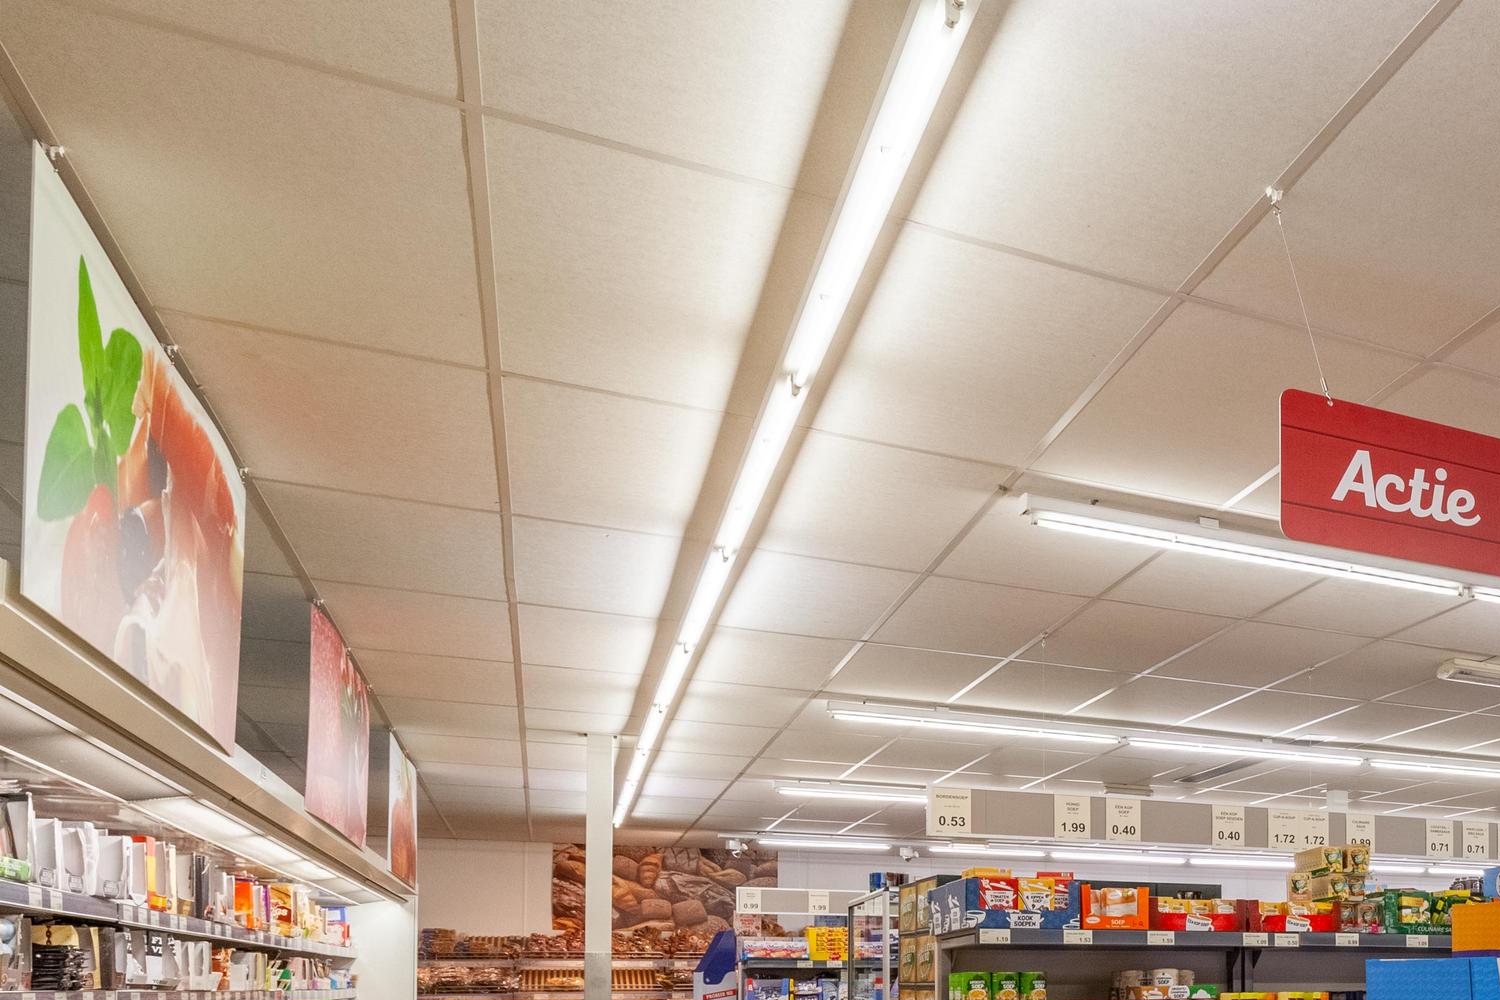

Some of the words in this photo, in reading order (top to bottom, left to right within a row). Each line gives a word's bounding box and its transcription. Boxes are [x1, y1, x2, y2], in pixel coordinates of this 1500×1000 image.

[1331, 449, 1482, 527] Actie
[938, 815, 966, 827] 0.53
[1061, 822, 1086, 833] 1.99
[1112, 824, 1136, 836] 0.40
[1218, 830, 1241, 841] 0.40
[1274, 833, 1295, 844] 1.72
[1304, 835, 1325, 846] 1.72
[1430, 842, 1449, 852] 0.71
[1467, 844, 1485, 854] 0.71
